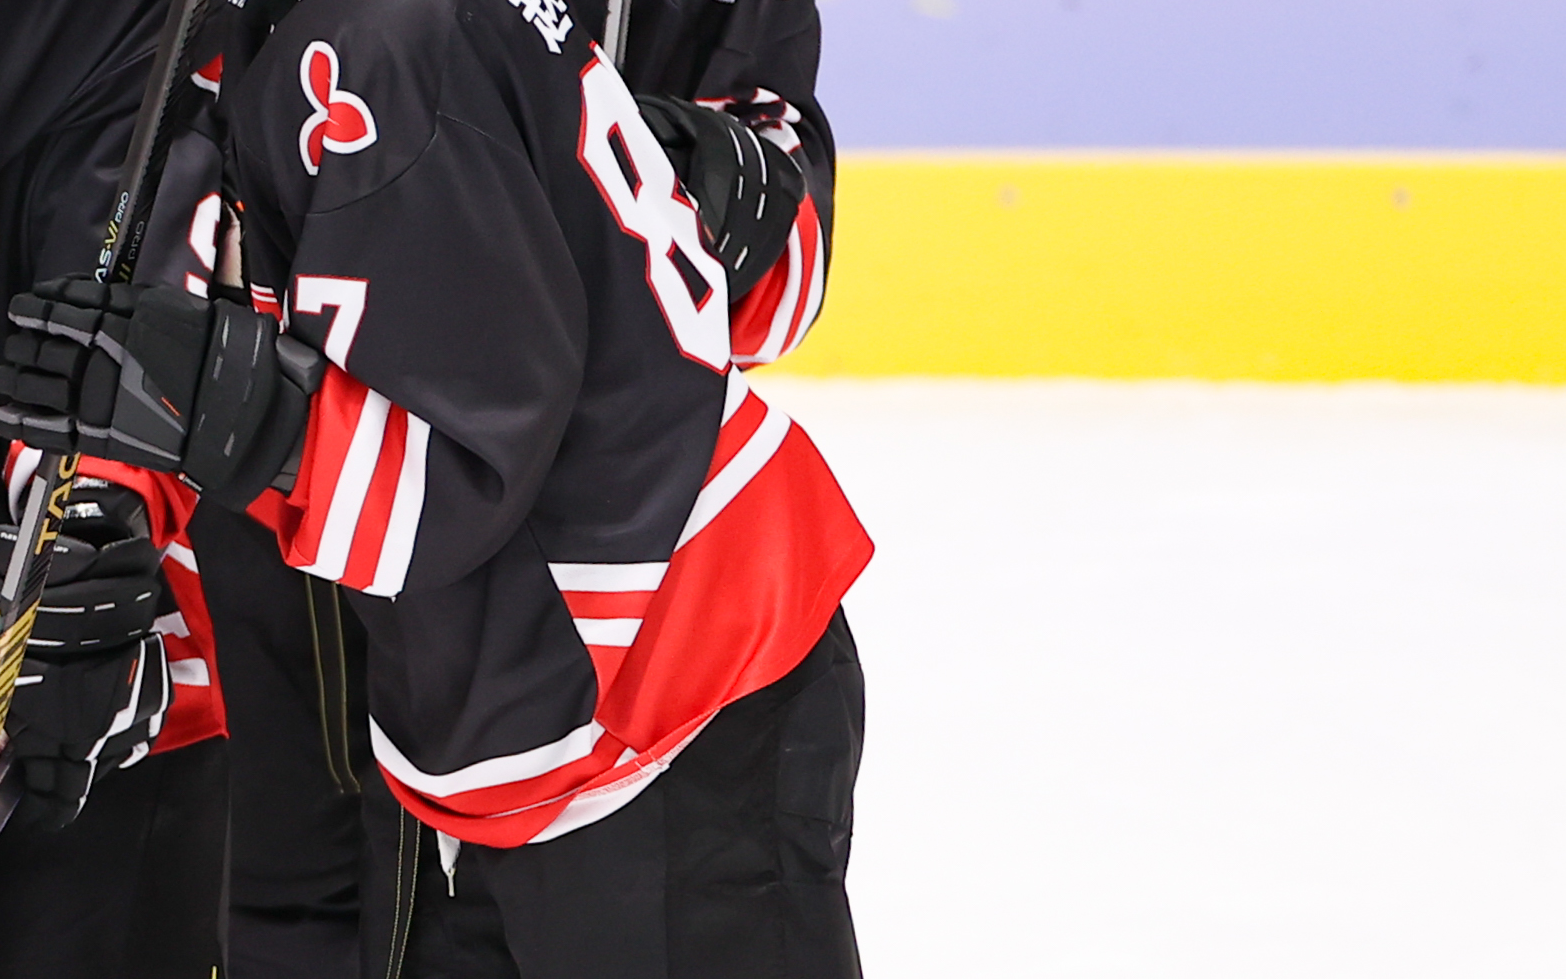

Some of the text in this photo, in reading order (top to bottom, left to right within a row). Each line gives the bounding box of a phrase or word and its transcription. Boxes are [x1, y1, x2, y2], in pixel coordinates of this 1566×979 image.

[576, 40, 732, 377] 8
[283, 273, 370, 371] 7
[35, 451, 82, 556] TAC
